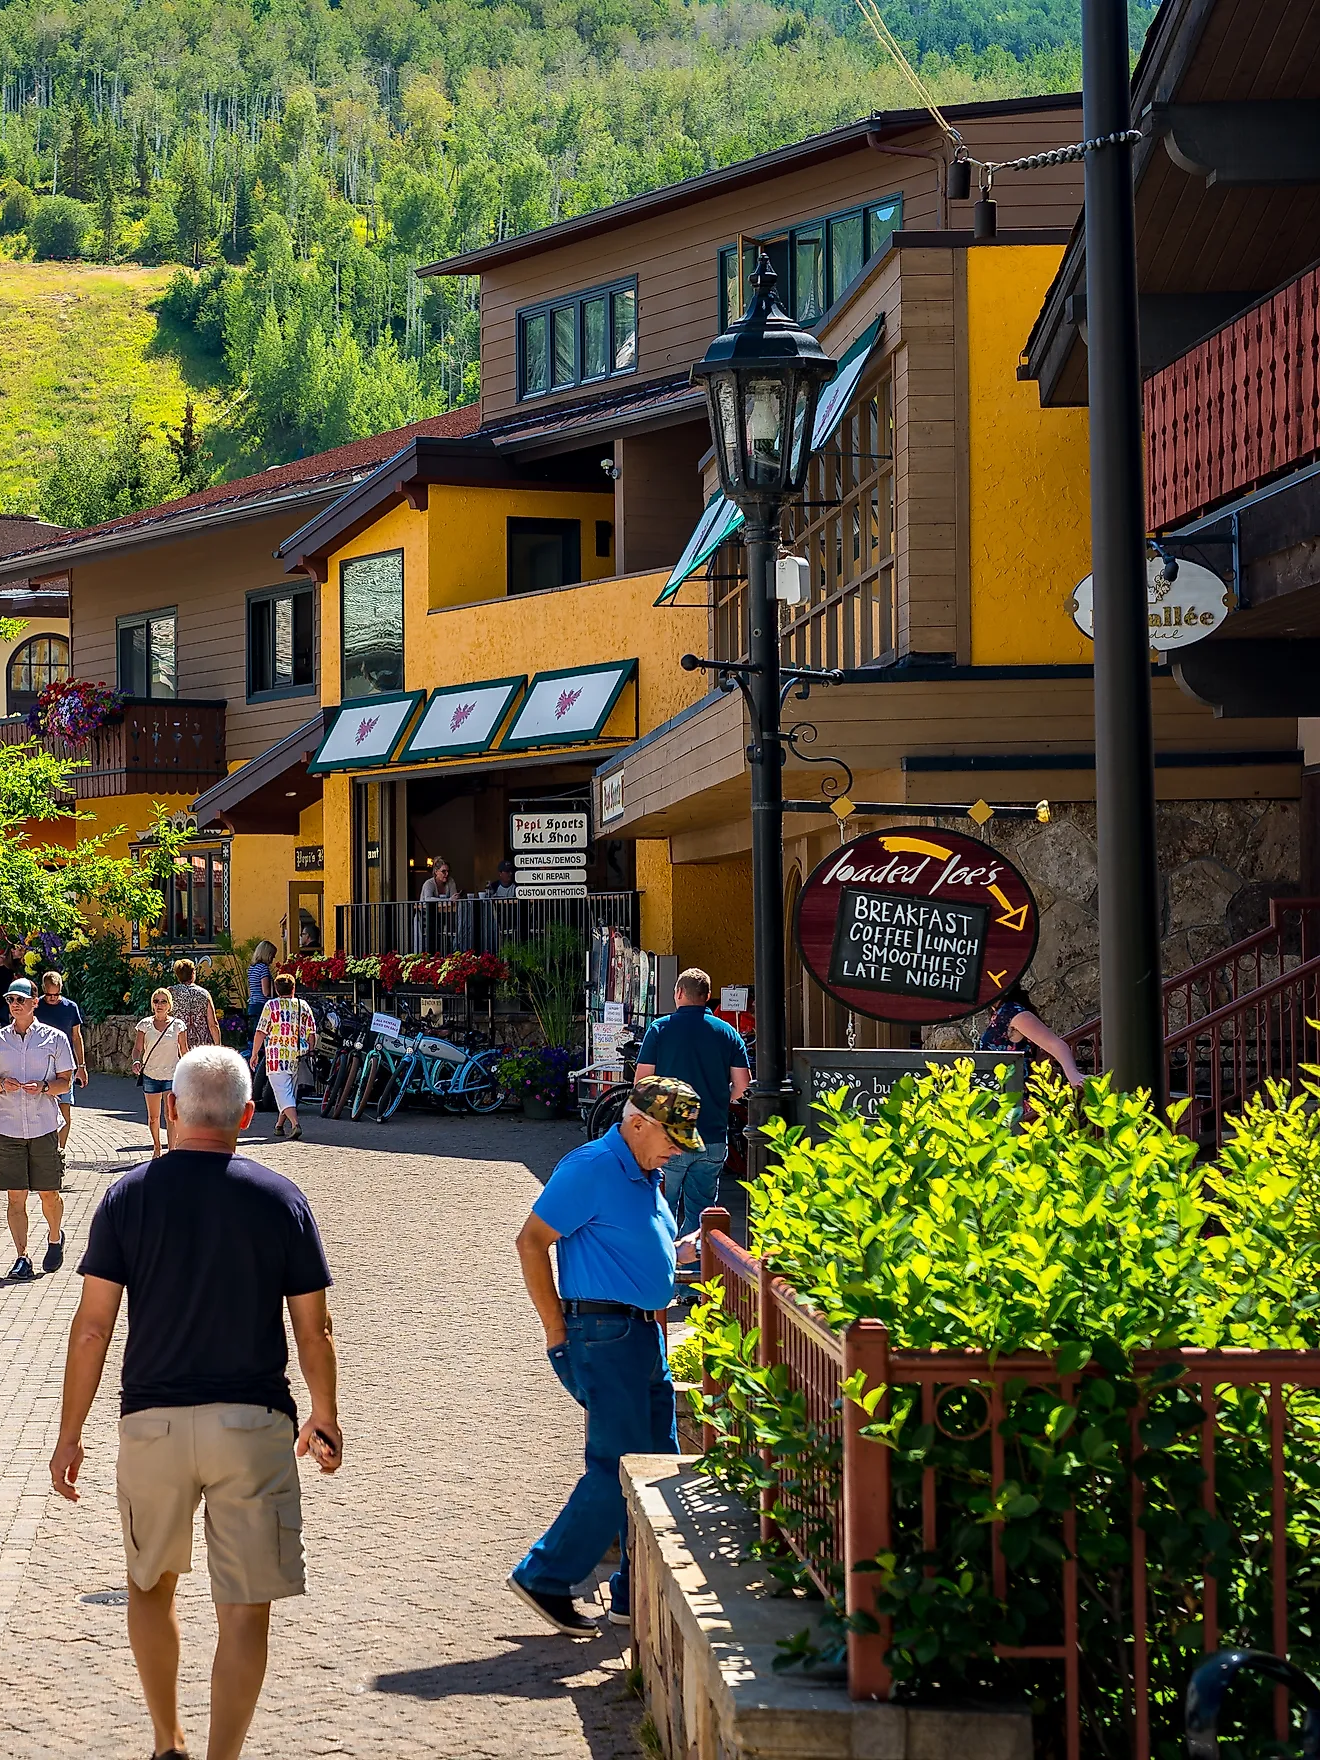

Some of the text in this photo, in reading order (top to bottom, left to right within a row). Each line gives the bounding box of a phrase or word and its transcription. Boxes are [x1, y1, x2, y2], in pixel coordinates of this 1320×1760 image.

[1148, 605, 1215, 627] allée
[545, 818, 584, 830] Sports
[522, 832, 577, 845] Ski Shop
[520, 855, 582, 865] RENTALS/DEMOS
[546, 872, 570, 880] REPAIR
[929, 854, 1005, 896] Joe's
[518, 887, 585, 897] CUSTOM ORTHOTICS
[854, 895, 973, 936] BREAKFAST
[849, 922, 979, 956] COFFEE LUNCH
[862, 943, 968, 975] SMOOTHIES
[842, 961, 964, 992] LATE NIGHT
